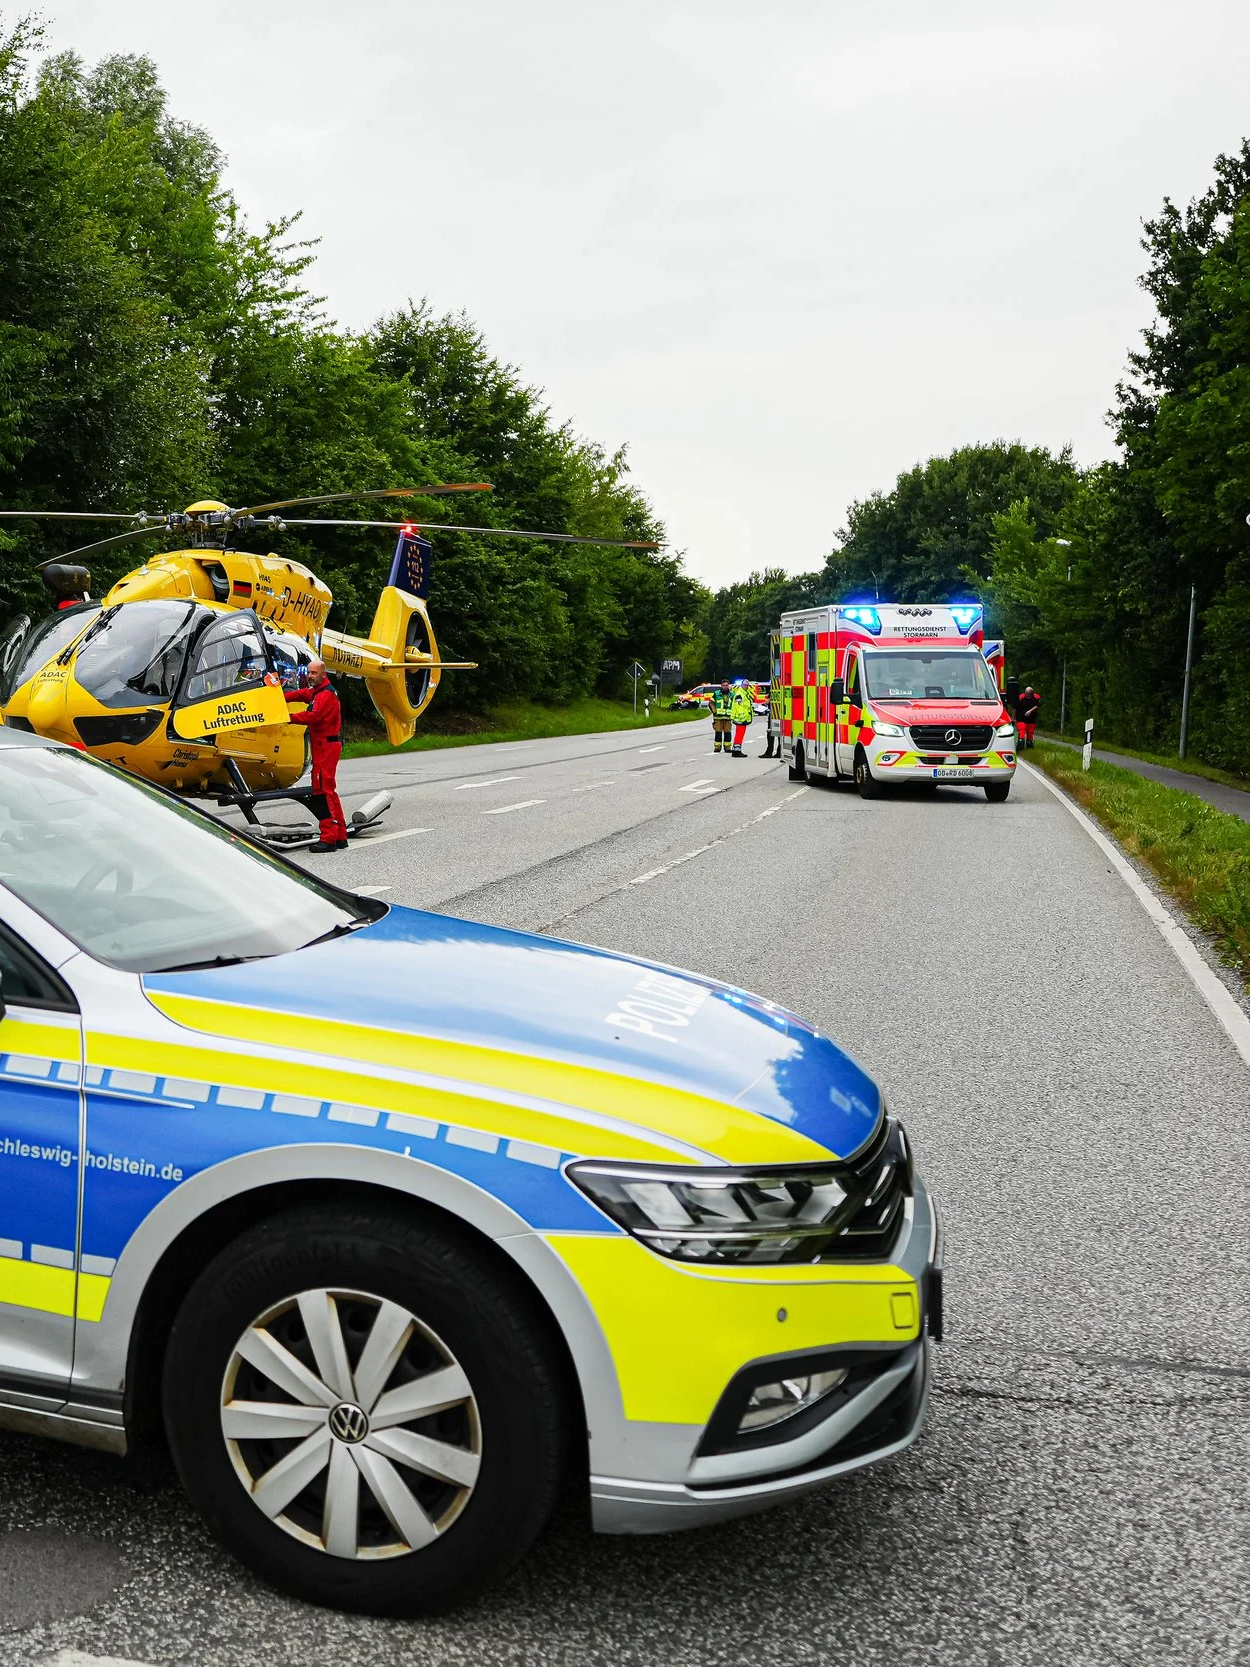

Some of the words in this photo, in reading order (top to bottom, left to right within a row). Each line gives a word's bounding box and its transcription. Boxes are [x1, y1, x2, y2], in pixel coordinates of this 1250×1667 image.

[217, 701, 247, 716] ADAC
[203, 712, 265, 730] Luftrettung
[908, 712, 992, 721] RETTUNGSDIENST
[173, 748, 200, 761] Christoph
[605, 971, 712, 1043] POLIZE
